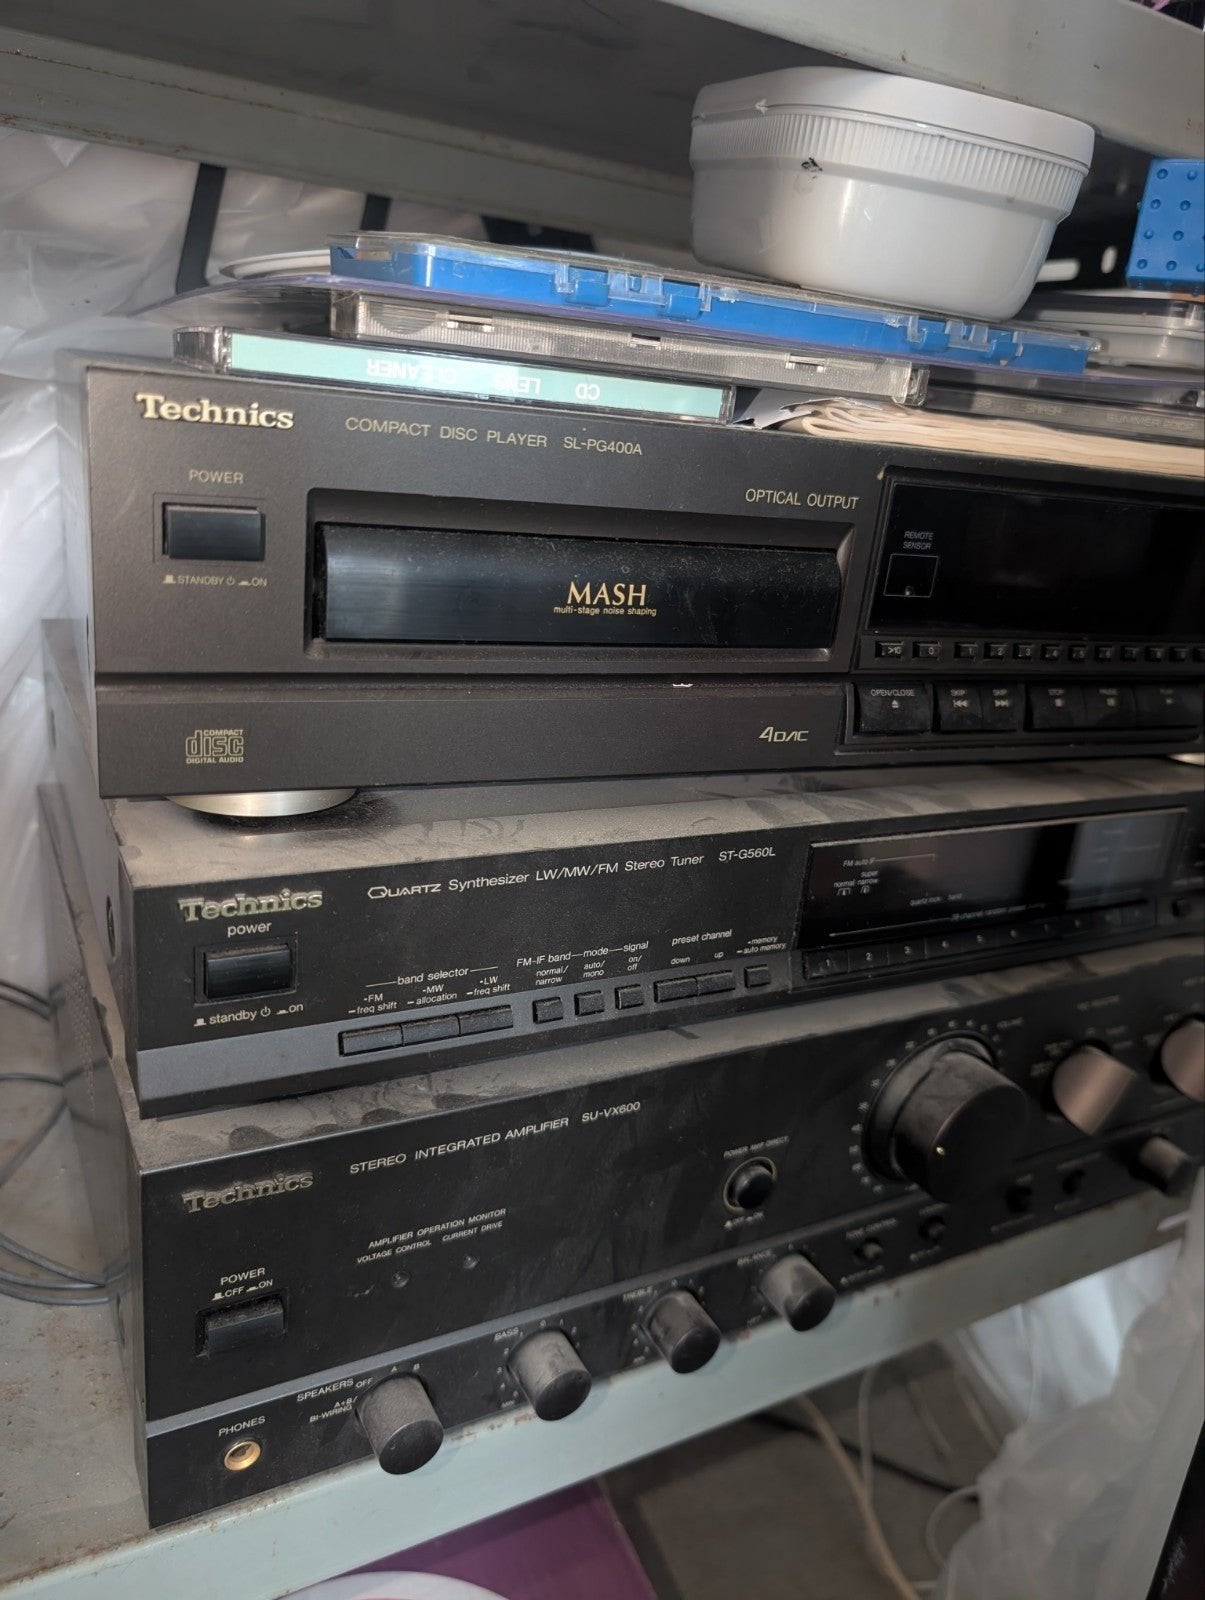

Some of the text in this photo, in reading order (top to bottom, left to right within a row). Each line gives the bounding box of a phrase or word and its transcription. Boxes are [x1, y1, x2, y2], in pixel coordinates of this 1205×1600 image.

[574, 383, 601, 402] CD
[135, 392, 294, 430] Technics
[345, 416, 643, 457] COMPACT DISC PLAYER SL-PG400A
[188, 468, 244, 485] POWER
[745, 487, 859, 511] OPTICAL OUTPUT
[904, 530, 935, 540] REMOTE
[903, 541, 932, 550] SENSOR
[177, 575, 267, 587] STANDBY ON
[566, 581, 647, 606] MASH
[553, 604, 657, 617] multi-stage noise shaping
[870, 688, 915, 698] OPEN/CLOSE
[203, 729, 244, 737] COMPACT
[186, 756, 244, 765] DIGITAL AUDIO
[366, 846, 777, 899] QUARTZ Synthesizer LW/MW/FM Stereo Tuner ST-G560L
[178, 887, 323, 923] Technics
[227, 922, 272, 938] power
[671, 928, 733, 947] preset channel
[583, 946, 609, 957] mode
[623, 940, 649, 954] signal
[760, 943, 787, 952] memory
[516, 951, 572, 968] FM-IF band
[671, 956, 691, 965] down
[714, 951, 724, 960] up
[583, 968, 604, 978] mono
[627, 963, 638, 971] off
[397, 967, 469, 986] band selector
[535, 976, 563, 986] narrow
[492, 983, 511, 994] shift
[209, 1003, 304, 1025] standby on
[377, 1001, 397, 1012] shift
[349, 1101, 641, 1175] STEREO INTEGRATED AMPLIFIER SU-VX600
[182, 1170, 314, 1213] Technics
[368, 1208, 507, 1249] AMPLIFIER OPERATION MONITOR
[356, 1220, 503, 1265] VOLTAGE CONTROL CURRENT DRIVE
[220, 1267, 265, 1285] POWER
[224, 1279, 273, 1298] OFF ON
[494, 1327, 519, 1342] BASS
[390, 1363, 420, 1373] A B
[297, 1378, 354, 1402] SPEAKERS
[356, 1377, 374, 1389] OFF
[309, 1405, 353, 1423] BI-WIRING
[218, 1415, 266, 1437] PHONES
